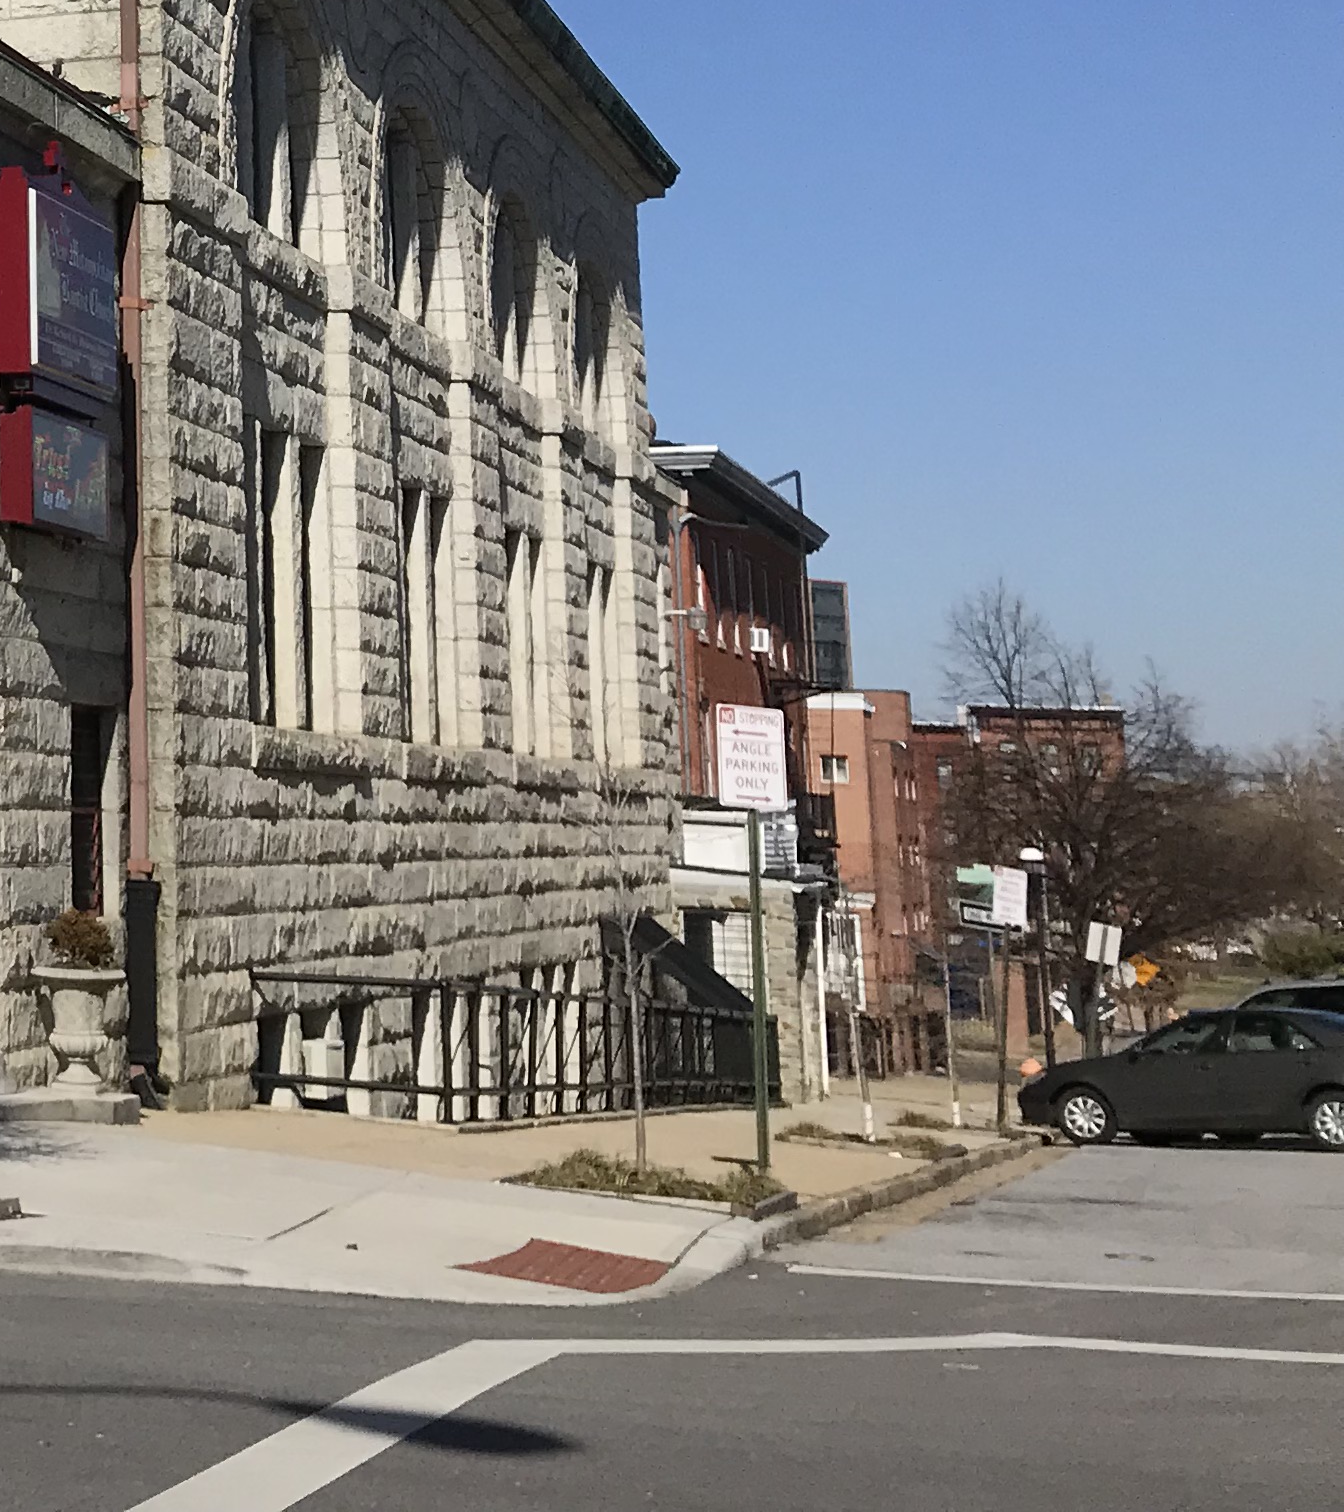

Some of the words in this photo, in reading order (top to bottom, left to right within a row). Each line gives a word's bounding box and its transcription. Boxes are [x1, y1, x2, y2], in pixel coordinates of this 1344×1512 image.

[722, 710, 733, 723] NO
[739, 712, 779, 728] STOPPING
[732, 741, 772, 757] ANGLE
[725, 757, 779, 774] PARKING
[736, 775, 768, 790] ONLY
